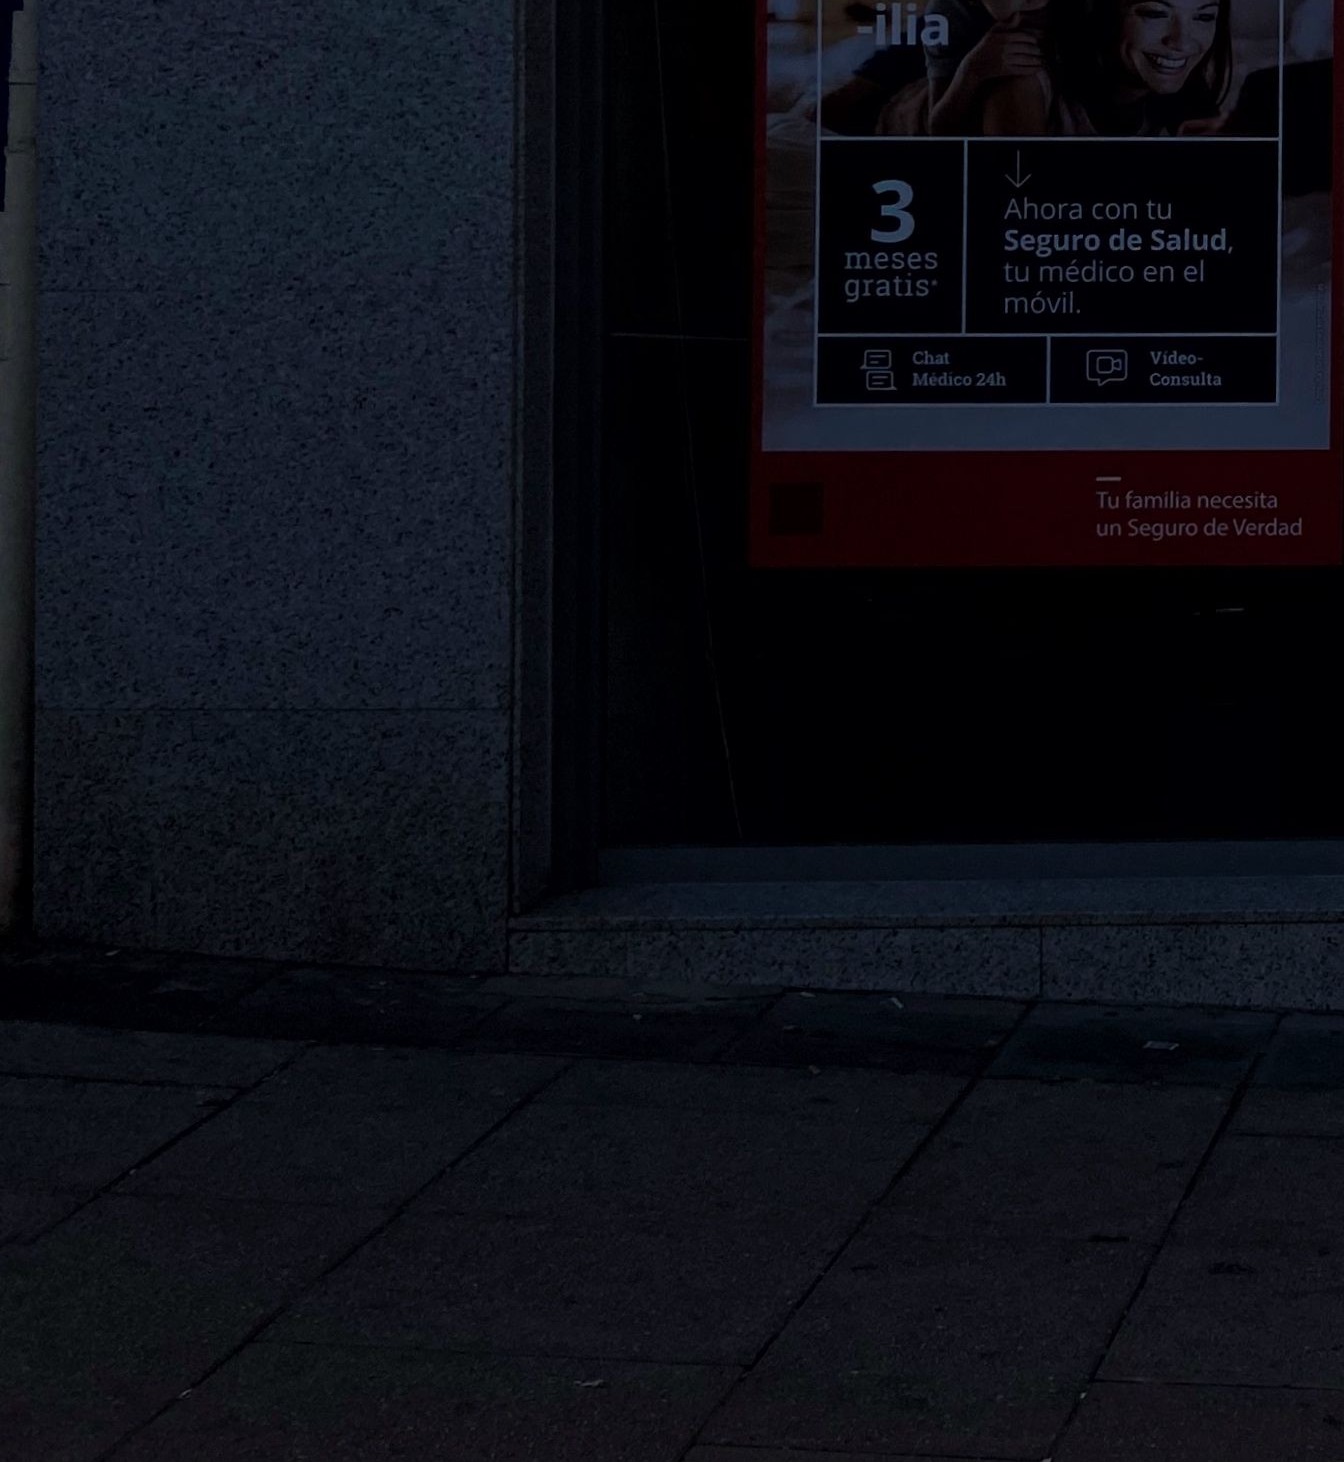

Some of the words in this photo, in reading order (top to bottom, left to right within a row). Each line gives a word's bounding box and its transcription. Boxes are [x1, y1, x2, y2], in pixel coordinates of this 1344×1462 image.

[871, 179, 915, 243] 3
[1003, 197, 1084, 220] Ahora
[1092, 203, 1138, 220] con
[1146, 199, 1172, 220] tu
[1003, 229, 1101, 258] Seguro
[1109, 228, 1143, 251] de
[1150, 228, 1234, 255] Salud,
[843, 251, 939, 270] meses
[1003, 261, 1030, 283] tu
[1039, 259, 1135, 283] médico
[1143, 264, 1175, 283] en
[1183, 259, 1205, 283] el
[1003, 291, 1081, 314] móvil.
[912, 351, 950, 366] Chat
[912, 372, 972, 387] Médico
[976, 372, 1008, 387] 24h
[1149, 372, 1222, 387] Consulta
[1096, 491, 1120, 509] Tu
[1125, 490, 1191, 509] familia
[1197, 491, 1278, 509] necesita
[1096, 522, 1122, 537] un
[1127, 518, 1198, 541] Seguro
[1203, 517, 1229, 537] de
[1233, 517, 1303, 537] Verdad
